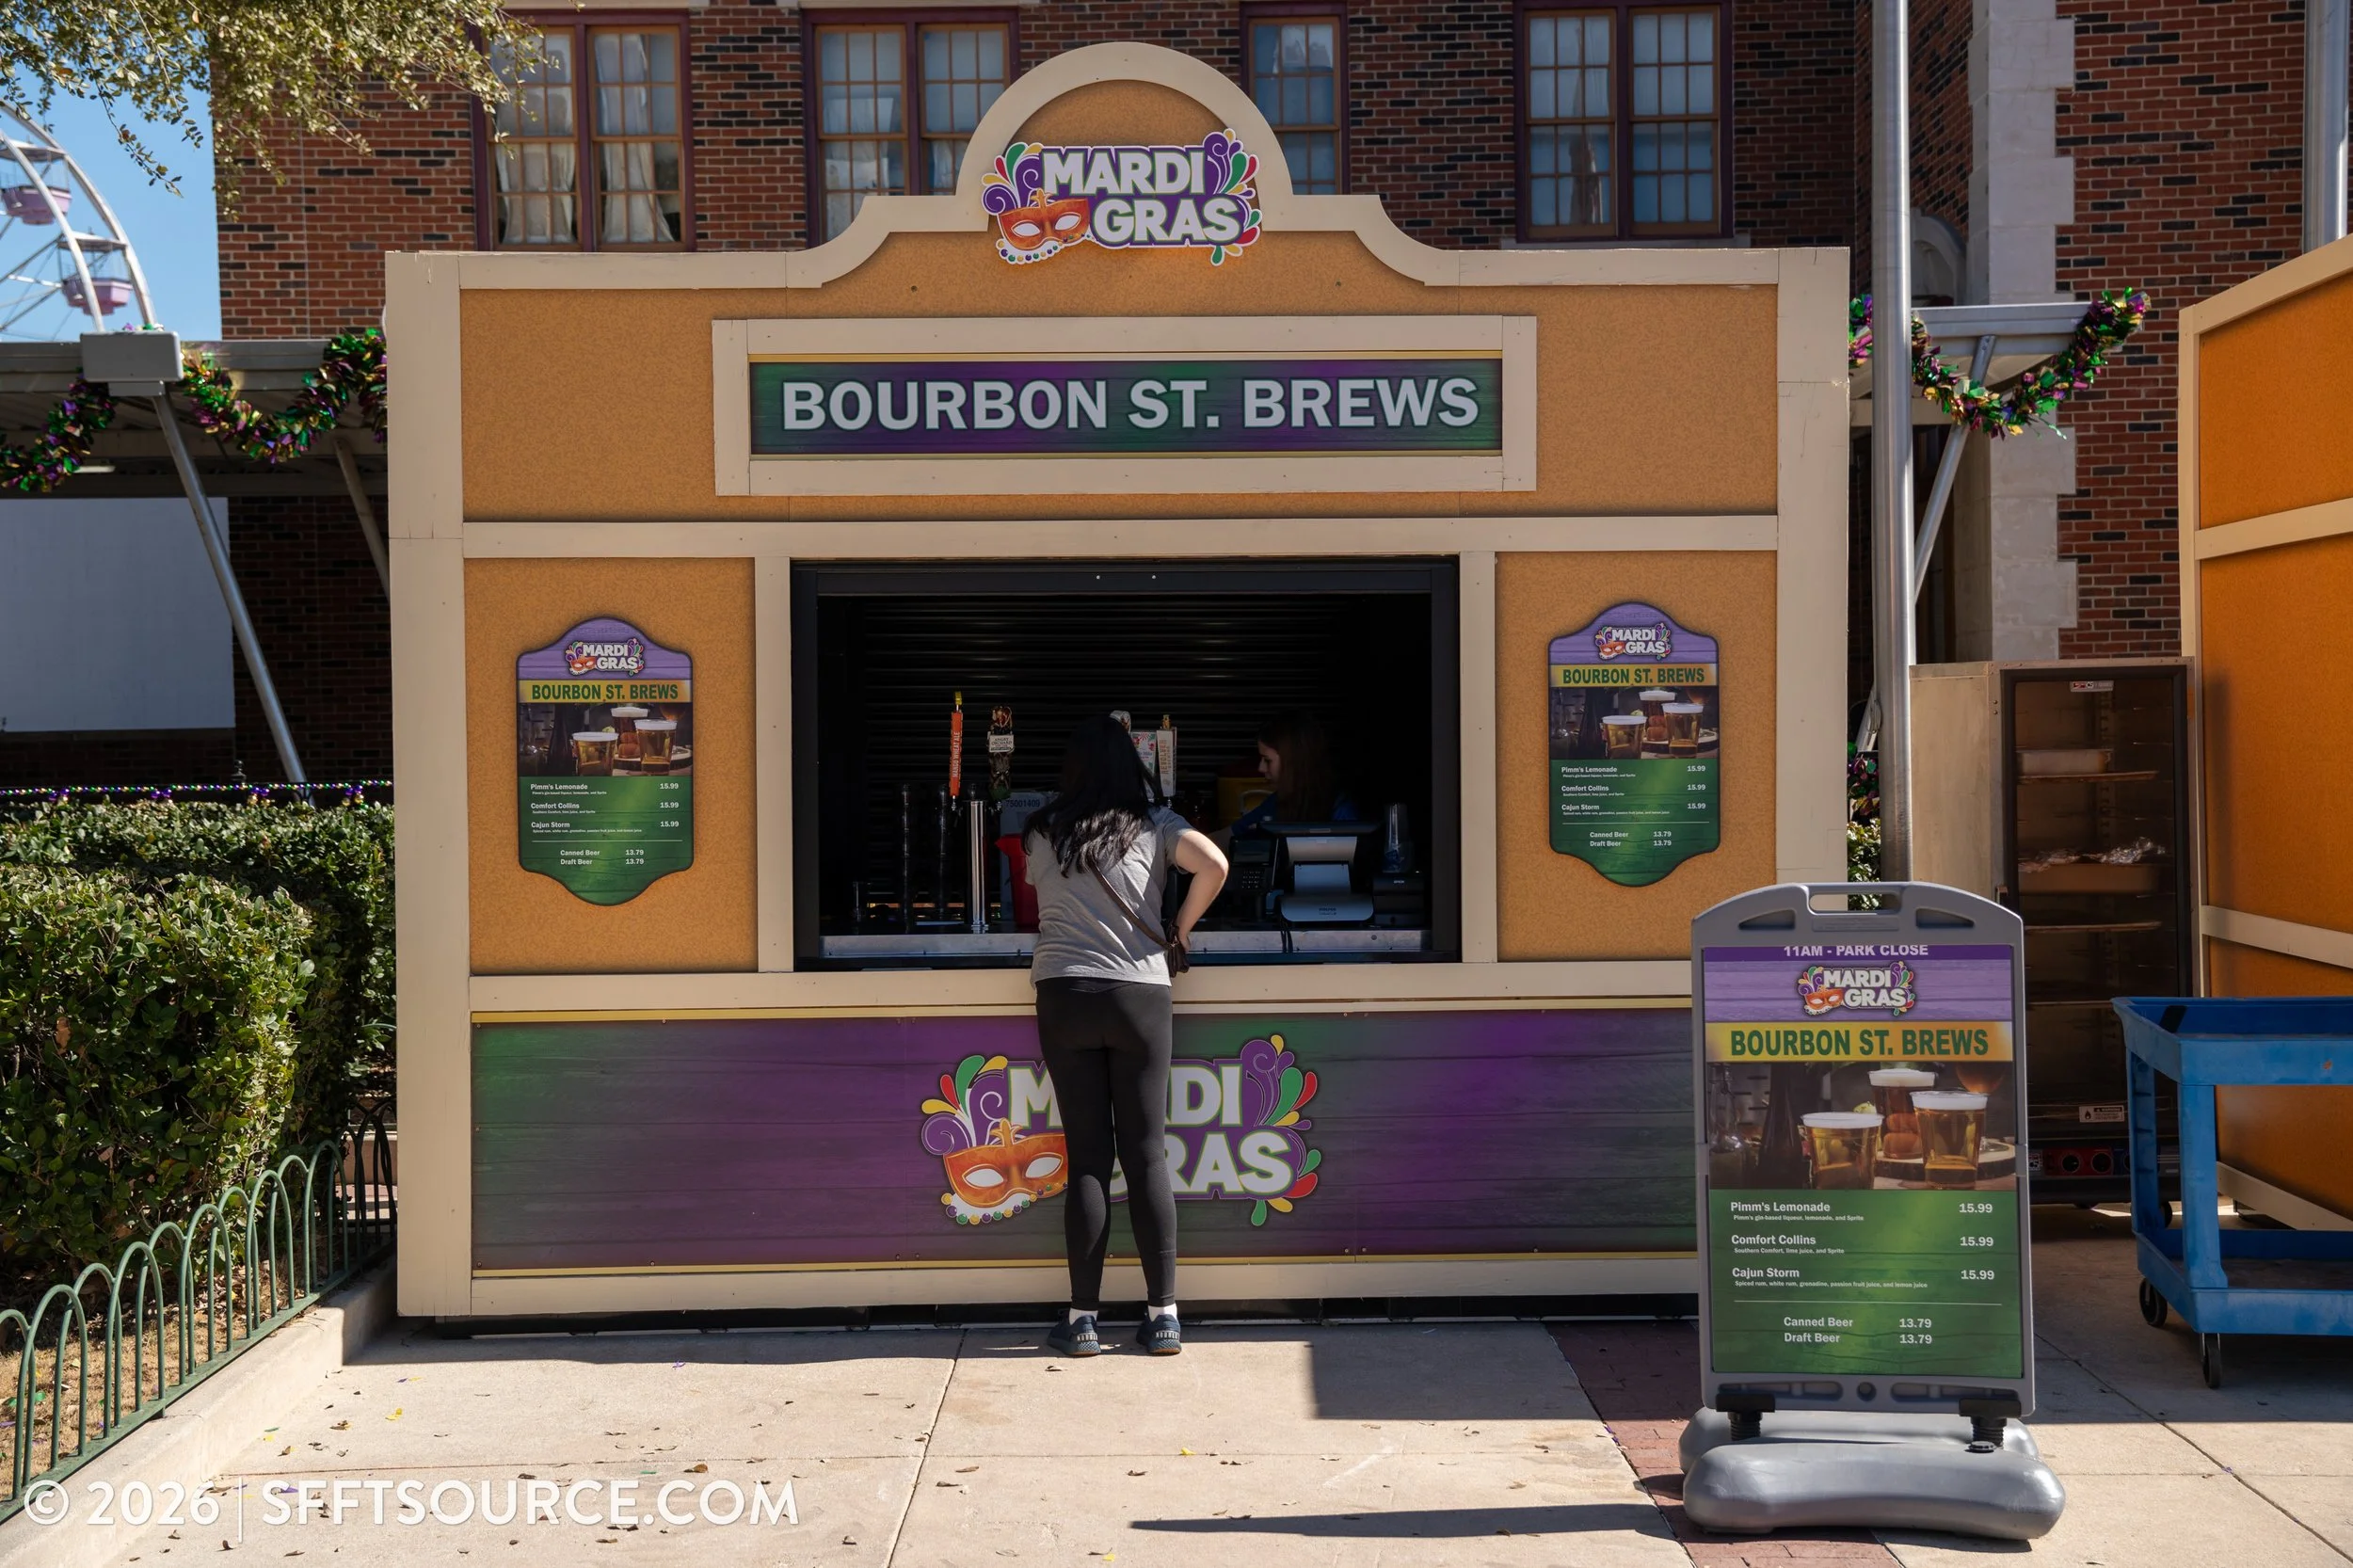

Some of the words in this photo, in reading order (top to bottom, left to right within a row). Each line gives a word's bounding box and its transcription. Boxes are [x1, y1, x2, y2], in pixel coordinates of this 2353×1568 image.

[1043, 150, 1205, 195] MARDI
[1094, 199, 1241, 242] GRAS
[782, 380, 1108, 430] BOURBON
[1128, 379, 1221, 428] ST.
[1243, 377, 1480, 428] BREWS
[1612, 629, 1656, 641] MARDI
[582, 644, 629, 657] MARDI
[1625, 642, 1666, 654] GRAS
[596, 657, 638, 670] GRAS
[1562, 669, 1629, 684] BOURBON
[1634, 669, 1653, 683] ST.
[1657, 668, 1705, 682] BREWS
[532, 684, 600, 699] BOURBON
[605, 684, 625, 699] ST.
[630, 684, 679, 699] BREWS
[1784, 945, 1824, 956] 11AM
[1836, 945, 1874, 956] PARK
[1880, 945, 1929, 956] CLOSE
[1823, 969, 1891, 988] MARDI
[1844, 988, 1906, 1007] GRAS
[1731, 1030, 1850, 1056] BOURBON
[1859, 1030, 1894, 1055] ST.
[1901, 1029, 1989, 1055] BREWS
[1008, 1064, 1242, 1128] MDI
[1109, 1130, 1292, 1194] RAS
[1730, 1201, 1770, 1212] Pimm's
[1773, 1201, 1831, 1212] Lemonade
[1959, 1203, 1993, 1213] 15.99
[1731, 1234, 1776, 1245] Comfort
[1778, 1234, 1817, 1245] Collins
[1960, 1236, 1994, 1247] 15.99
[1732, 1267, 1764, 1279] Cajun
[1767, 1268, 1801, 1278] Storm
[1961, 1270, 1995, 1280] 15.99
[1784, 1317, 1825, 1328] Canned
[1827, 1318, 1853, 1328] Beer
[1899, 1318, 1932, 1329] 13.79
[1784, 1332, 1811, 1344] Draft
[1814, 1333, 1841, 1344] Beer
[1899, 1334, 1932, 1345] 13.79
